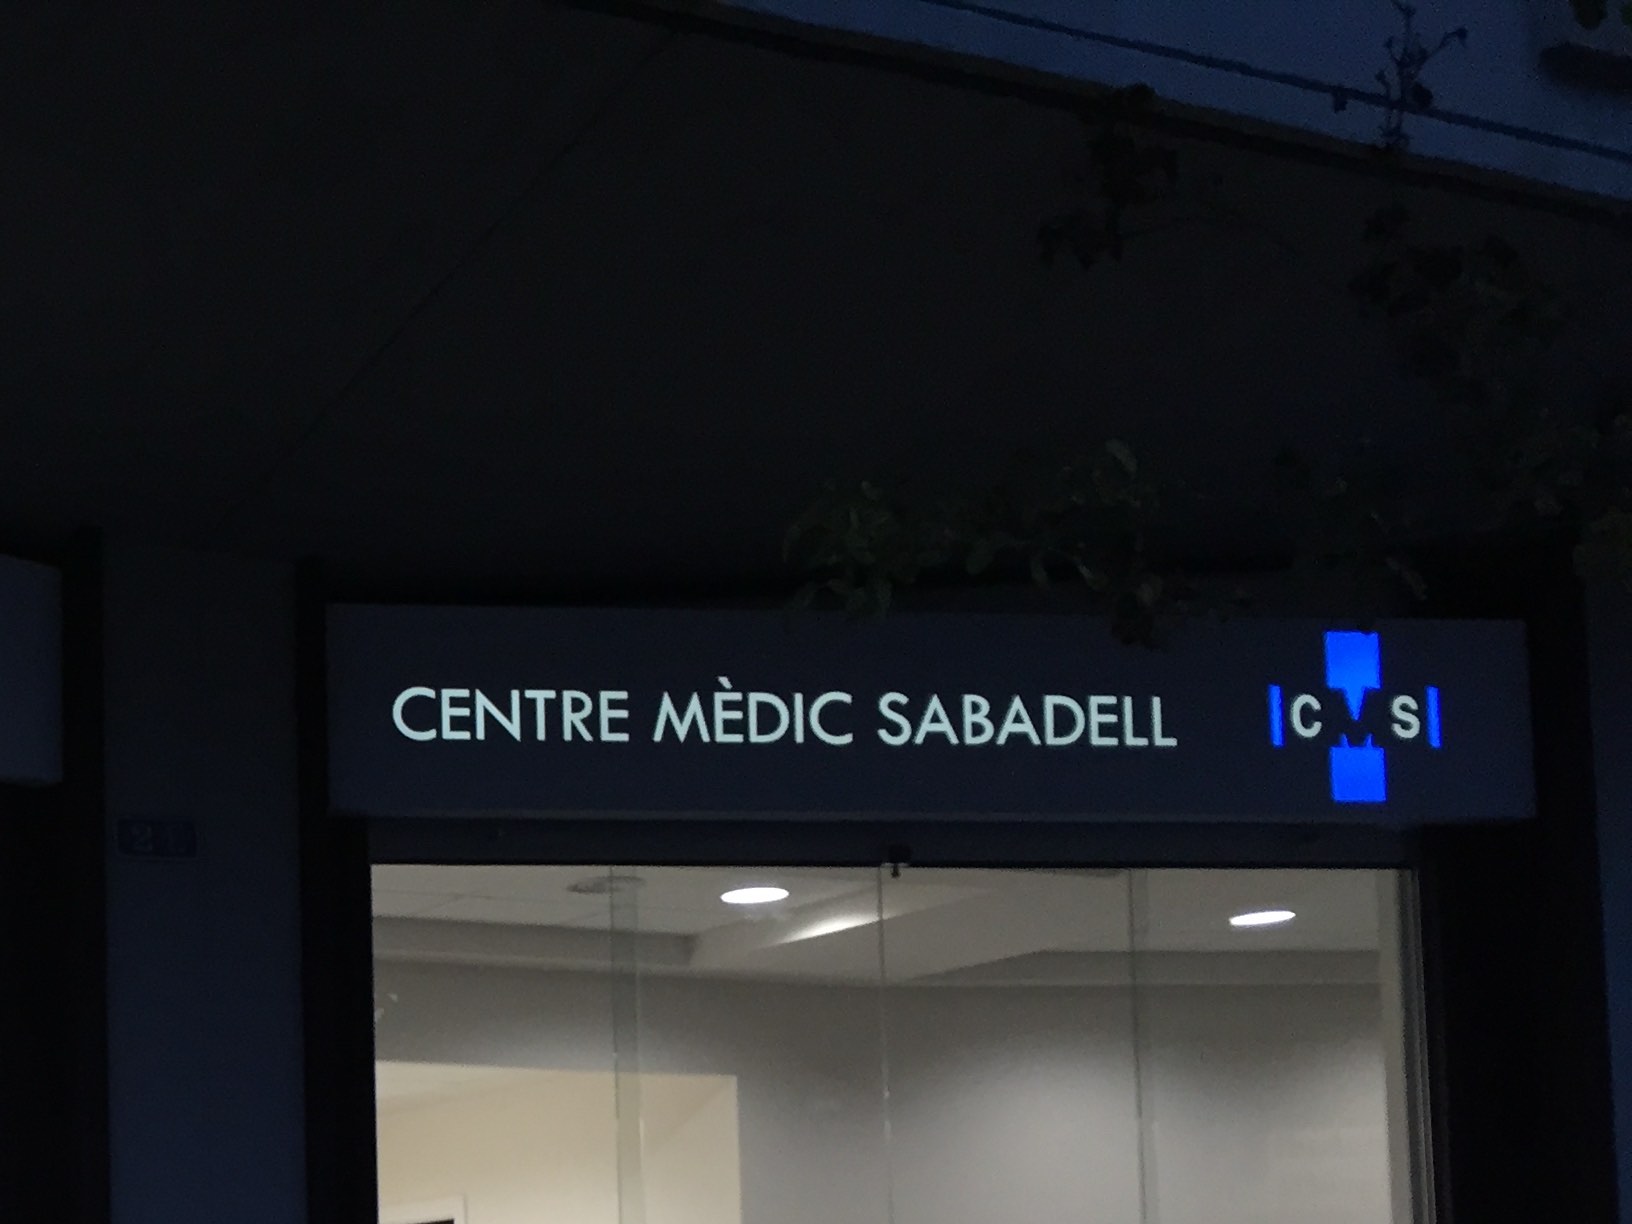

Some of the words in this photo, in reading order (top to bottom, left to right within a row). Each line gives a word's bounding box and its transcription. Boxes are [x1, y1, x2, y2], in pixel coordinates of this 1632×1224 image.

[391, 685, 631, 743] CENTRE
[651, 675, 855, 747] MÈDIC
[876, 690, 1179, 748] SABADELL
